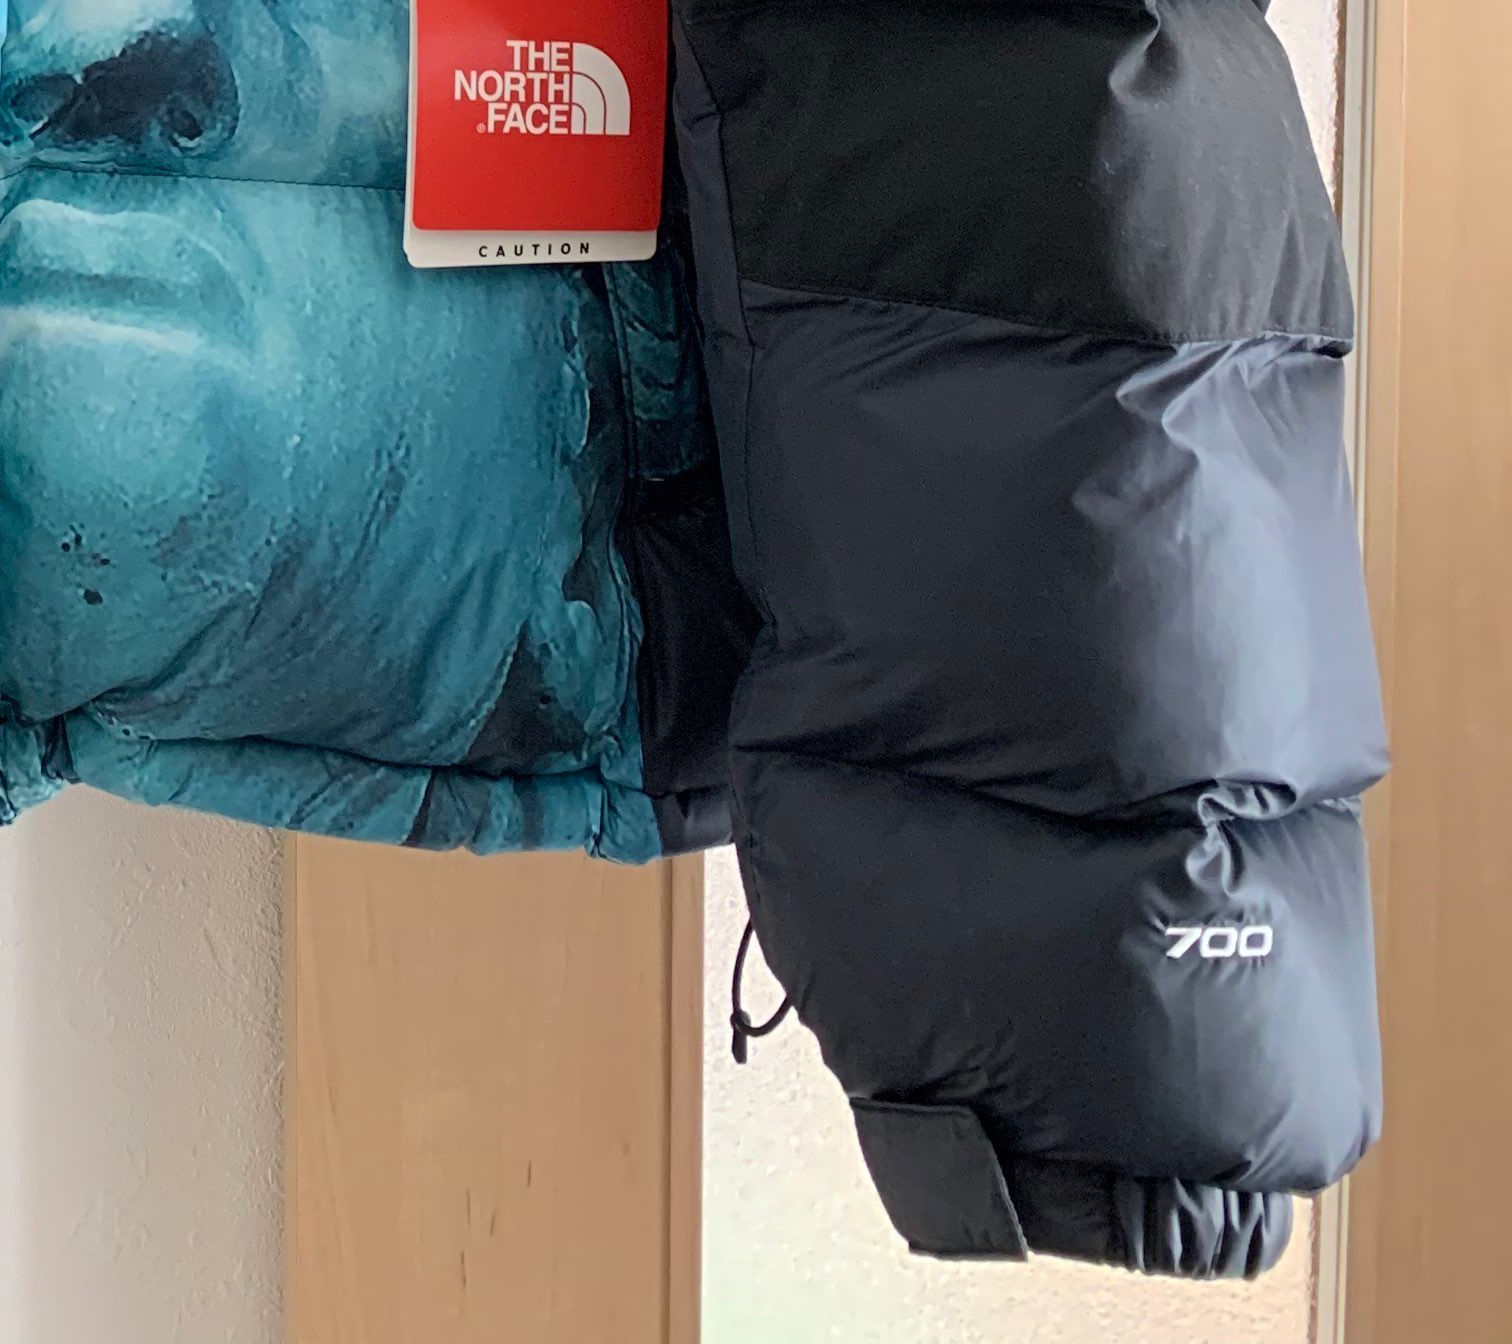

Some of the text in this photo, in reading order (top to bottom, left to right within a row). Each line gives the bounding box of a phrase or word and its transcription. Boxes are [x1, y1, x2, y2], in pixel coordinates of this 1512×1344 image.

[506, 40, 571, 72] THE
[454, 69, 571, 103] NORTH
[488, 102, 569, 134] FACE
[478, 242, 590, 258] CAUTION
[1165, 924, 1273, 958] 700
